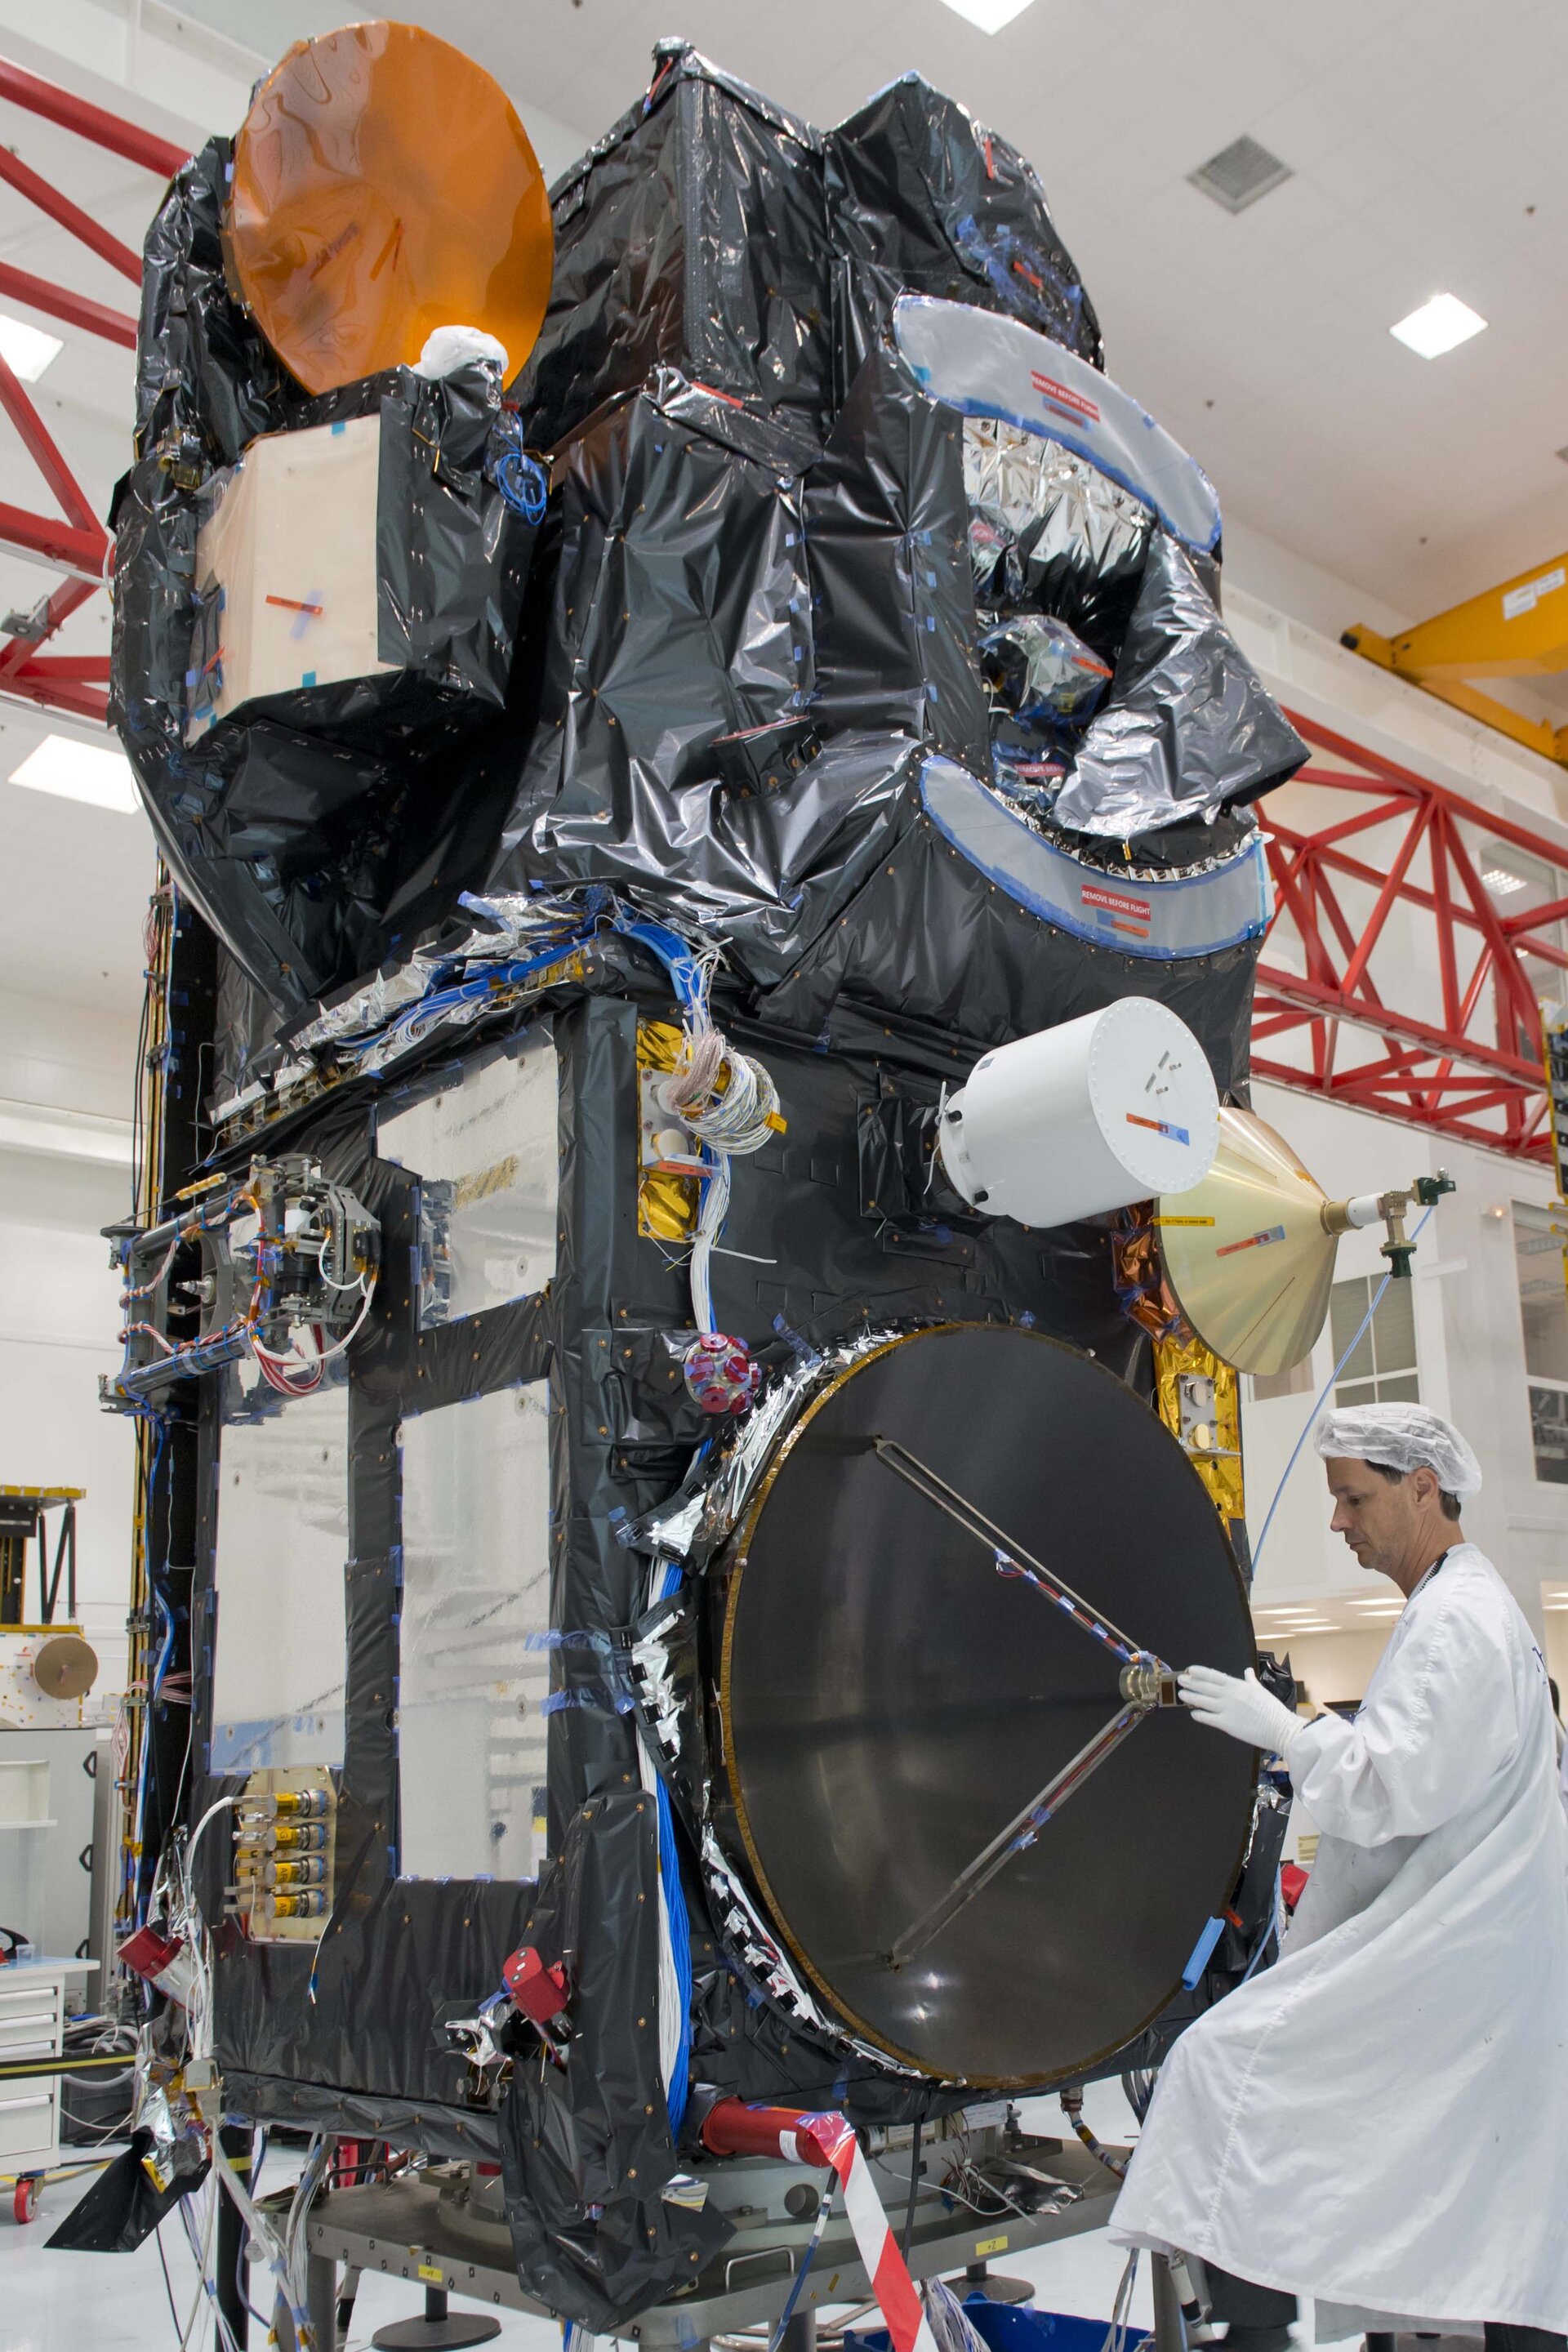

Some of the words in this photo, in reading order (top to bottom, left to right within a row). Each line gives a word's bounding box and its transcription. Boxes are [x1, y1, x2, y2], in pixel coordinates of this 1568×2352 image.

[1081, 889, 1108, 904] REMOVE
[1108, 897, 1129, 911] BEFORE
[1130, 903, 1151, 915] FLIGHT
